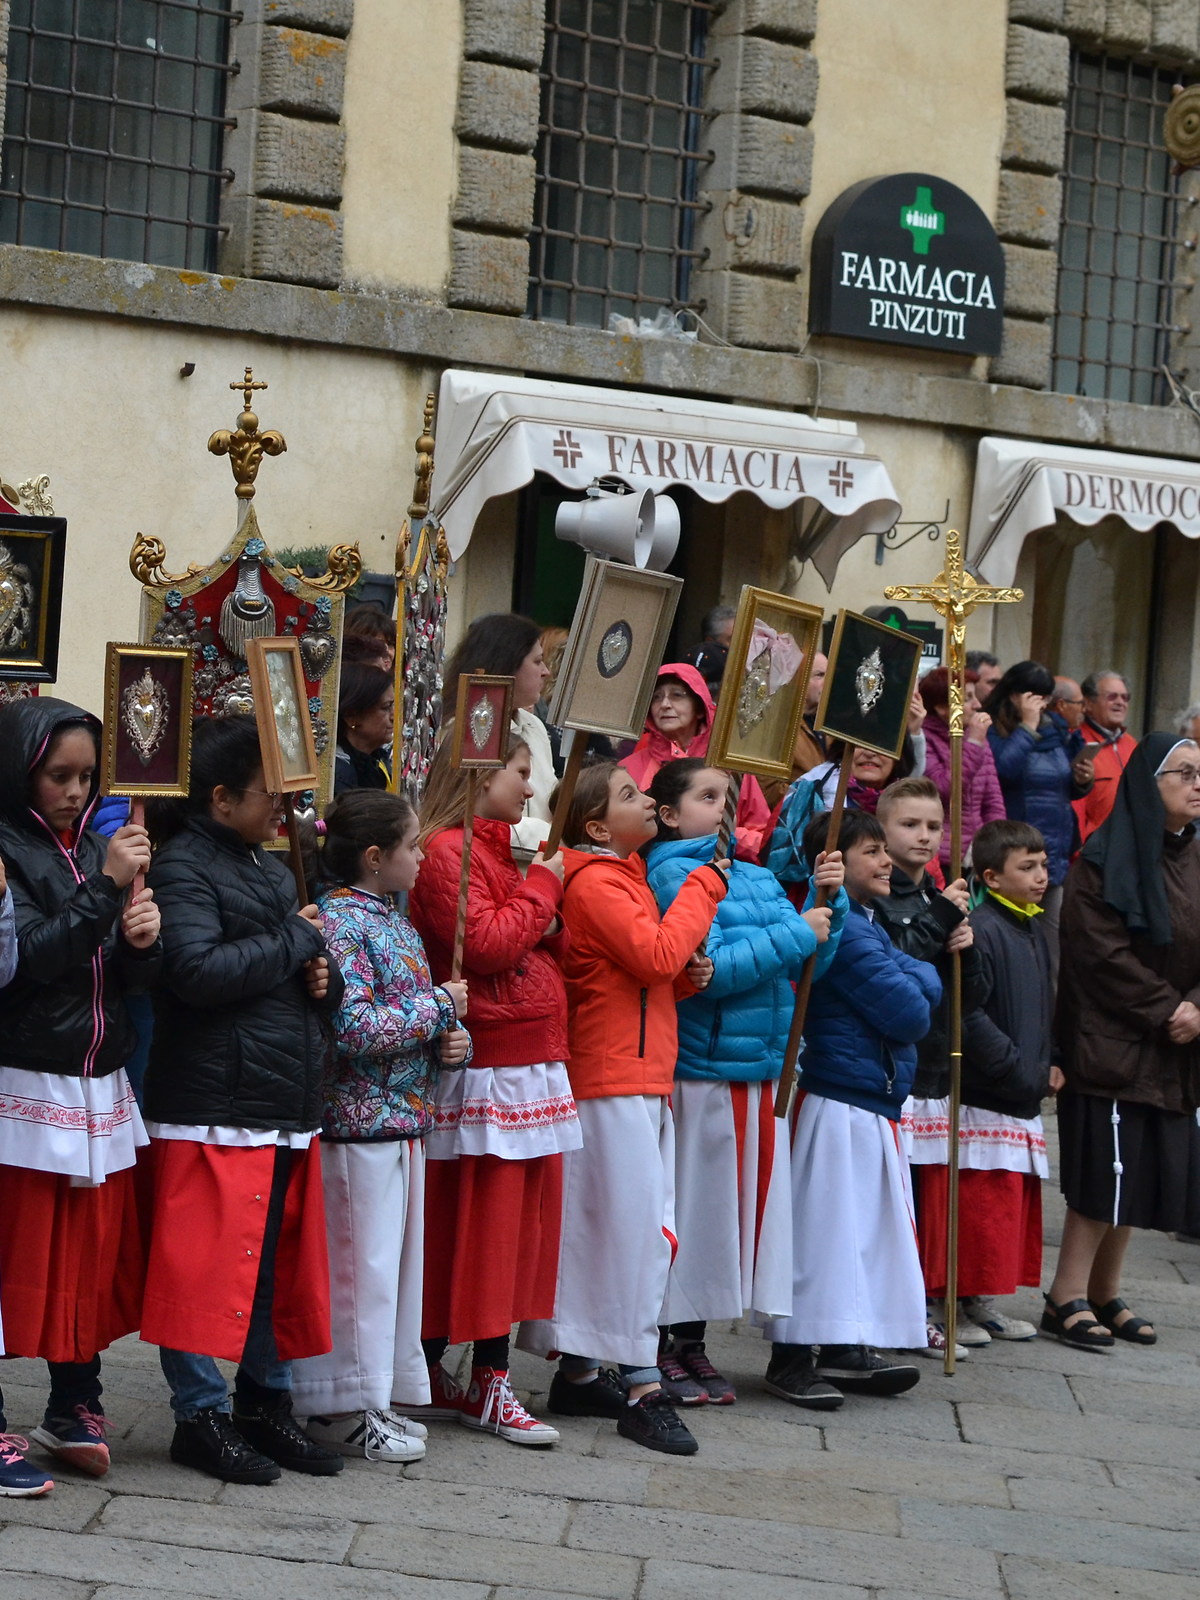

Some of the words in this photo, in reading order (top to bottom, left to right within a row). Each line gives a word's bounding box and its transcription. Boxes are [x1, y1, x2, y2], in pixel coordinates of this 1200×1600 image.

[840, 251, 997, 310] FARMACIA
[869, 298, 967, 340] PINZUTI
[605, 434, 806, 494] FARMACIA
[1063, 471, 1200, 521] DERMOC
